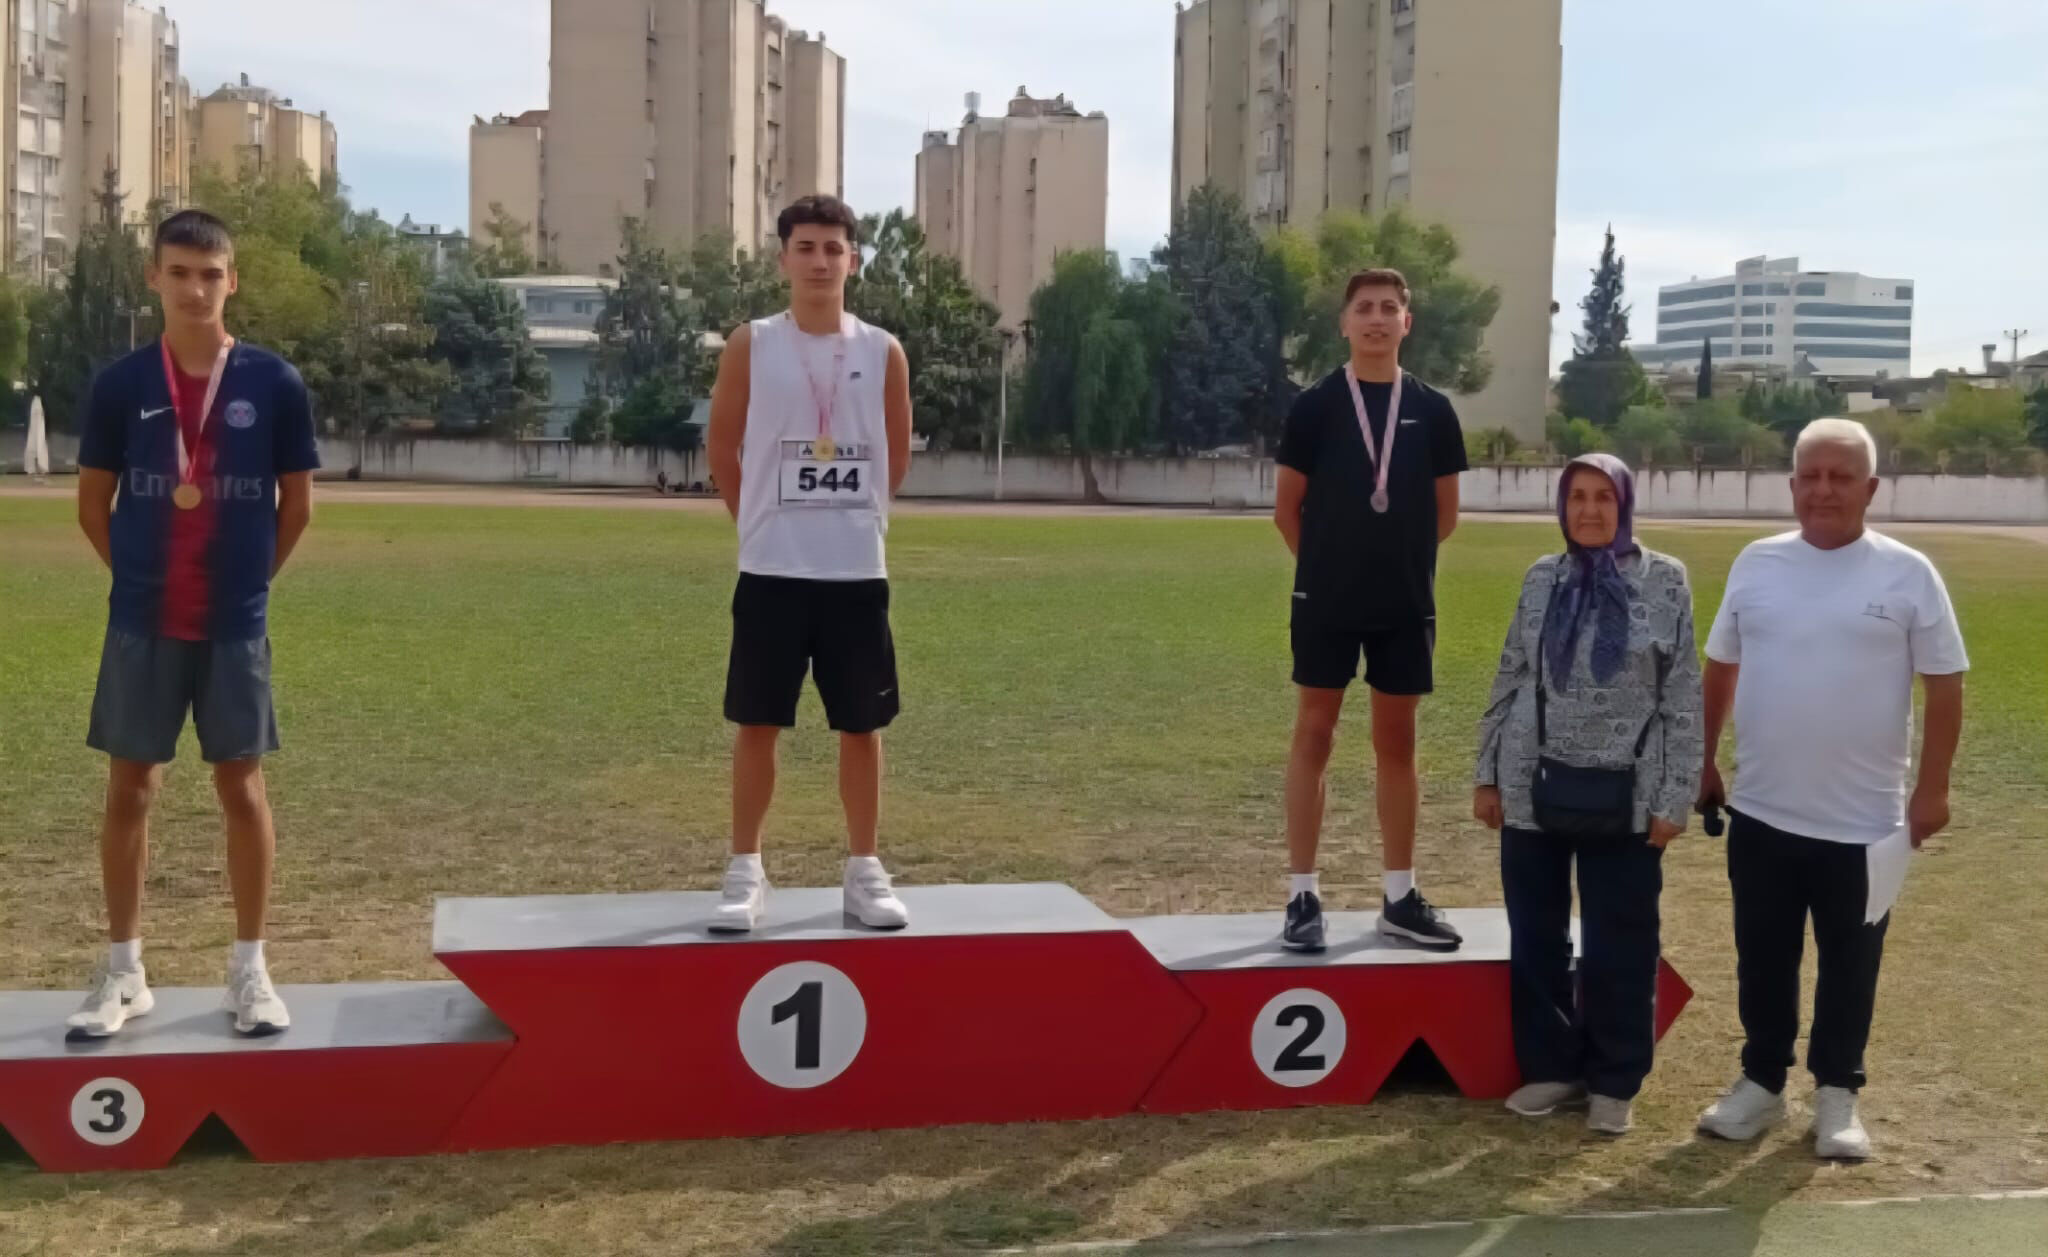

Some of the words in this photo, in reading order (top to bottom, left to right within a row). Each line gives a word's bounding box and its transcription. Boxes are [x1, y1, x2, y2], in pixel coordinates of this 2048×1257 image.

[798, 466, 860, 492] 544
[771, 981, 823, 1070] 1
[1273, 1004, 1326, 1072] 2
[88, 1088, 127, 1133] 3
